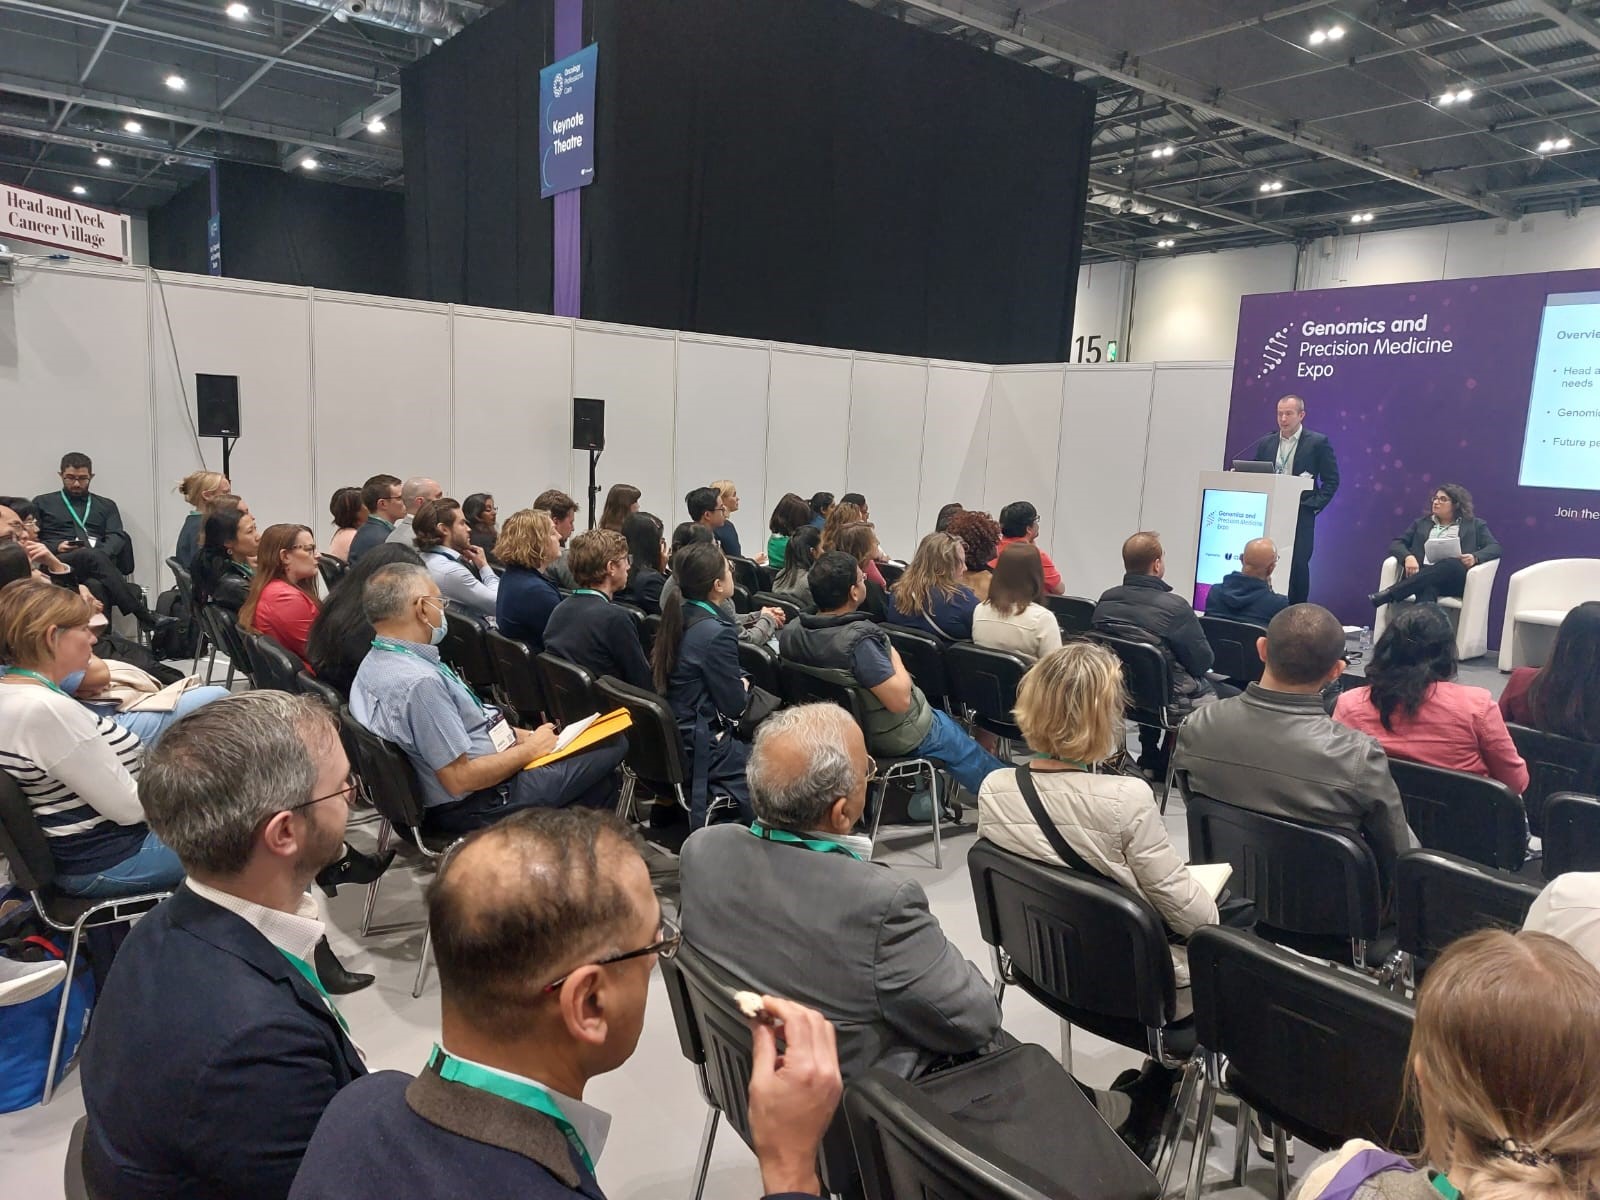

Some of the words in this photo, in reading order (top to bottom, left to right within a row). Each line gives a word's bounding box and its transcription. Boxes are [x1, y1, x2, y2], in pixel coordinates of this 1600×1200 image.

[552, 111, 584, 135] Keynote
[553, 134, 583, 155] Theatre
[7, 191, 44, 214] Head
[46, 205, 71, 220] and
[74, 208, 105, 229] Neck
[8, 211, 59, 236] Cancer
[62, 223, 105, 249] Village
[1301, 317, 1386, 337] Genomics
[1390, 314, 1428, 332] and
[1075, 335, 1102, 363] 15
[1299, 339, 1369, 357] Precision
[1373, 336, 1453, 355] Medicine
[1297, 362, 1334, 381] Expo
[1563, 366, 1592, 375] Head
[1561, 379, 1593, 388] needs
[1552, 437, 1587, 447] Future
[1554, 506, 1578, 518] Join
[1581, 508, 1600, 520] the
